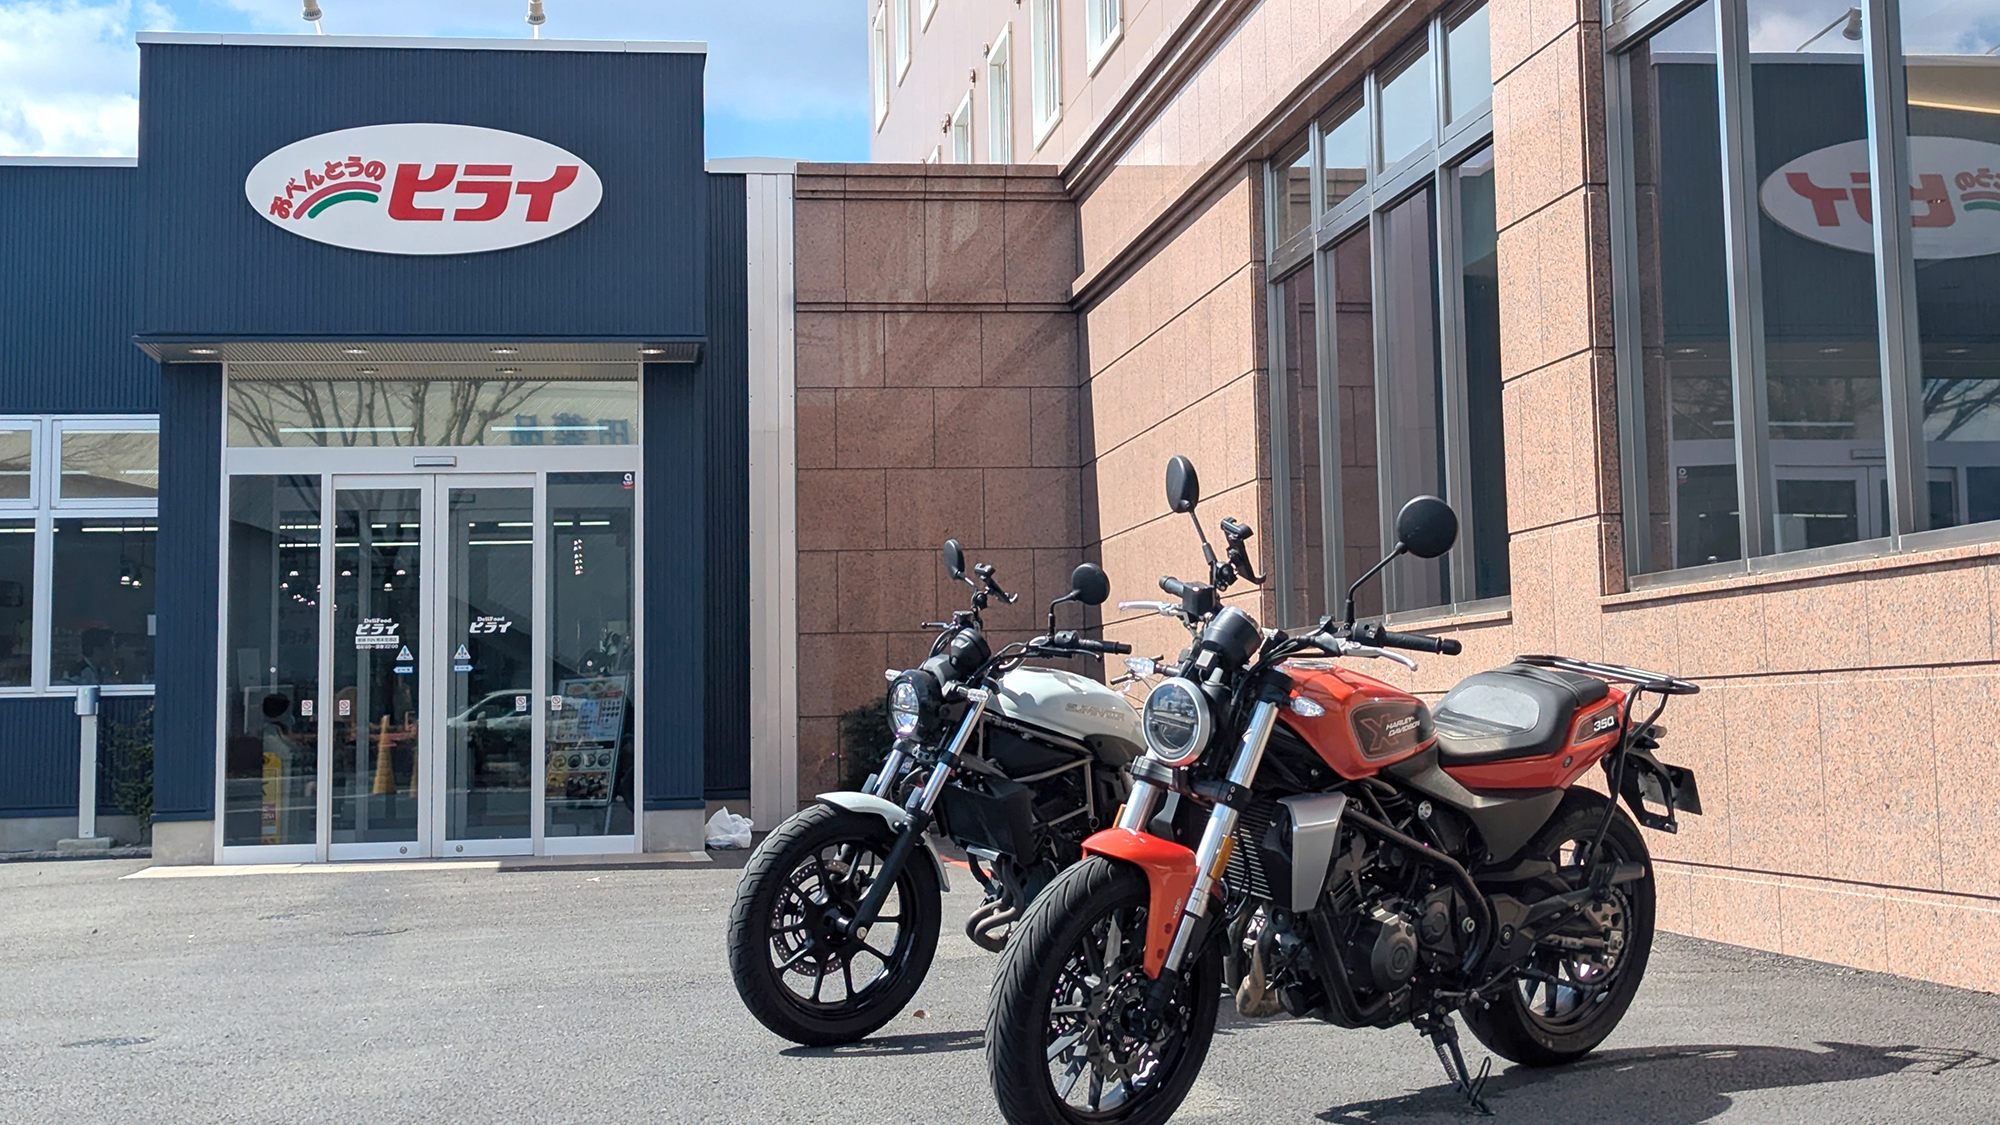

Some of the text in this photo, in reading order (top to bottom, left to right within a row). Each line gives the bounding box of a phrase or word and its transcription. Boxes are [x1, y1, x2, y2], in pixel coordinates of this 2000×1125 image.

[269, 155, 387, 220] おべんとうの
[387, 163, 580, 222] ヒライ
[355, 622, 400, 636] ヒライ
[469, 621, 513, 635] ヒライ
[1388, 720, 1421, 737] DAVIDSON
[1593, 715, 1615, 732] 350
